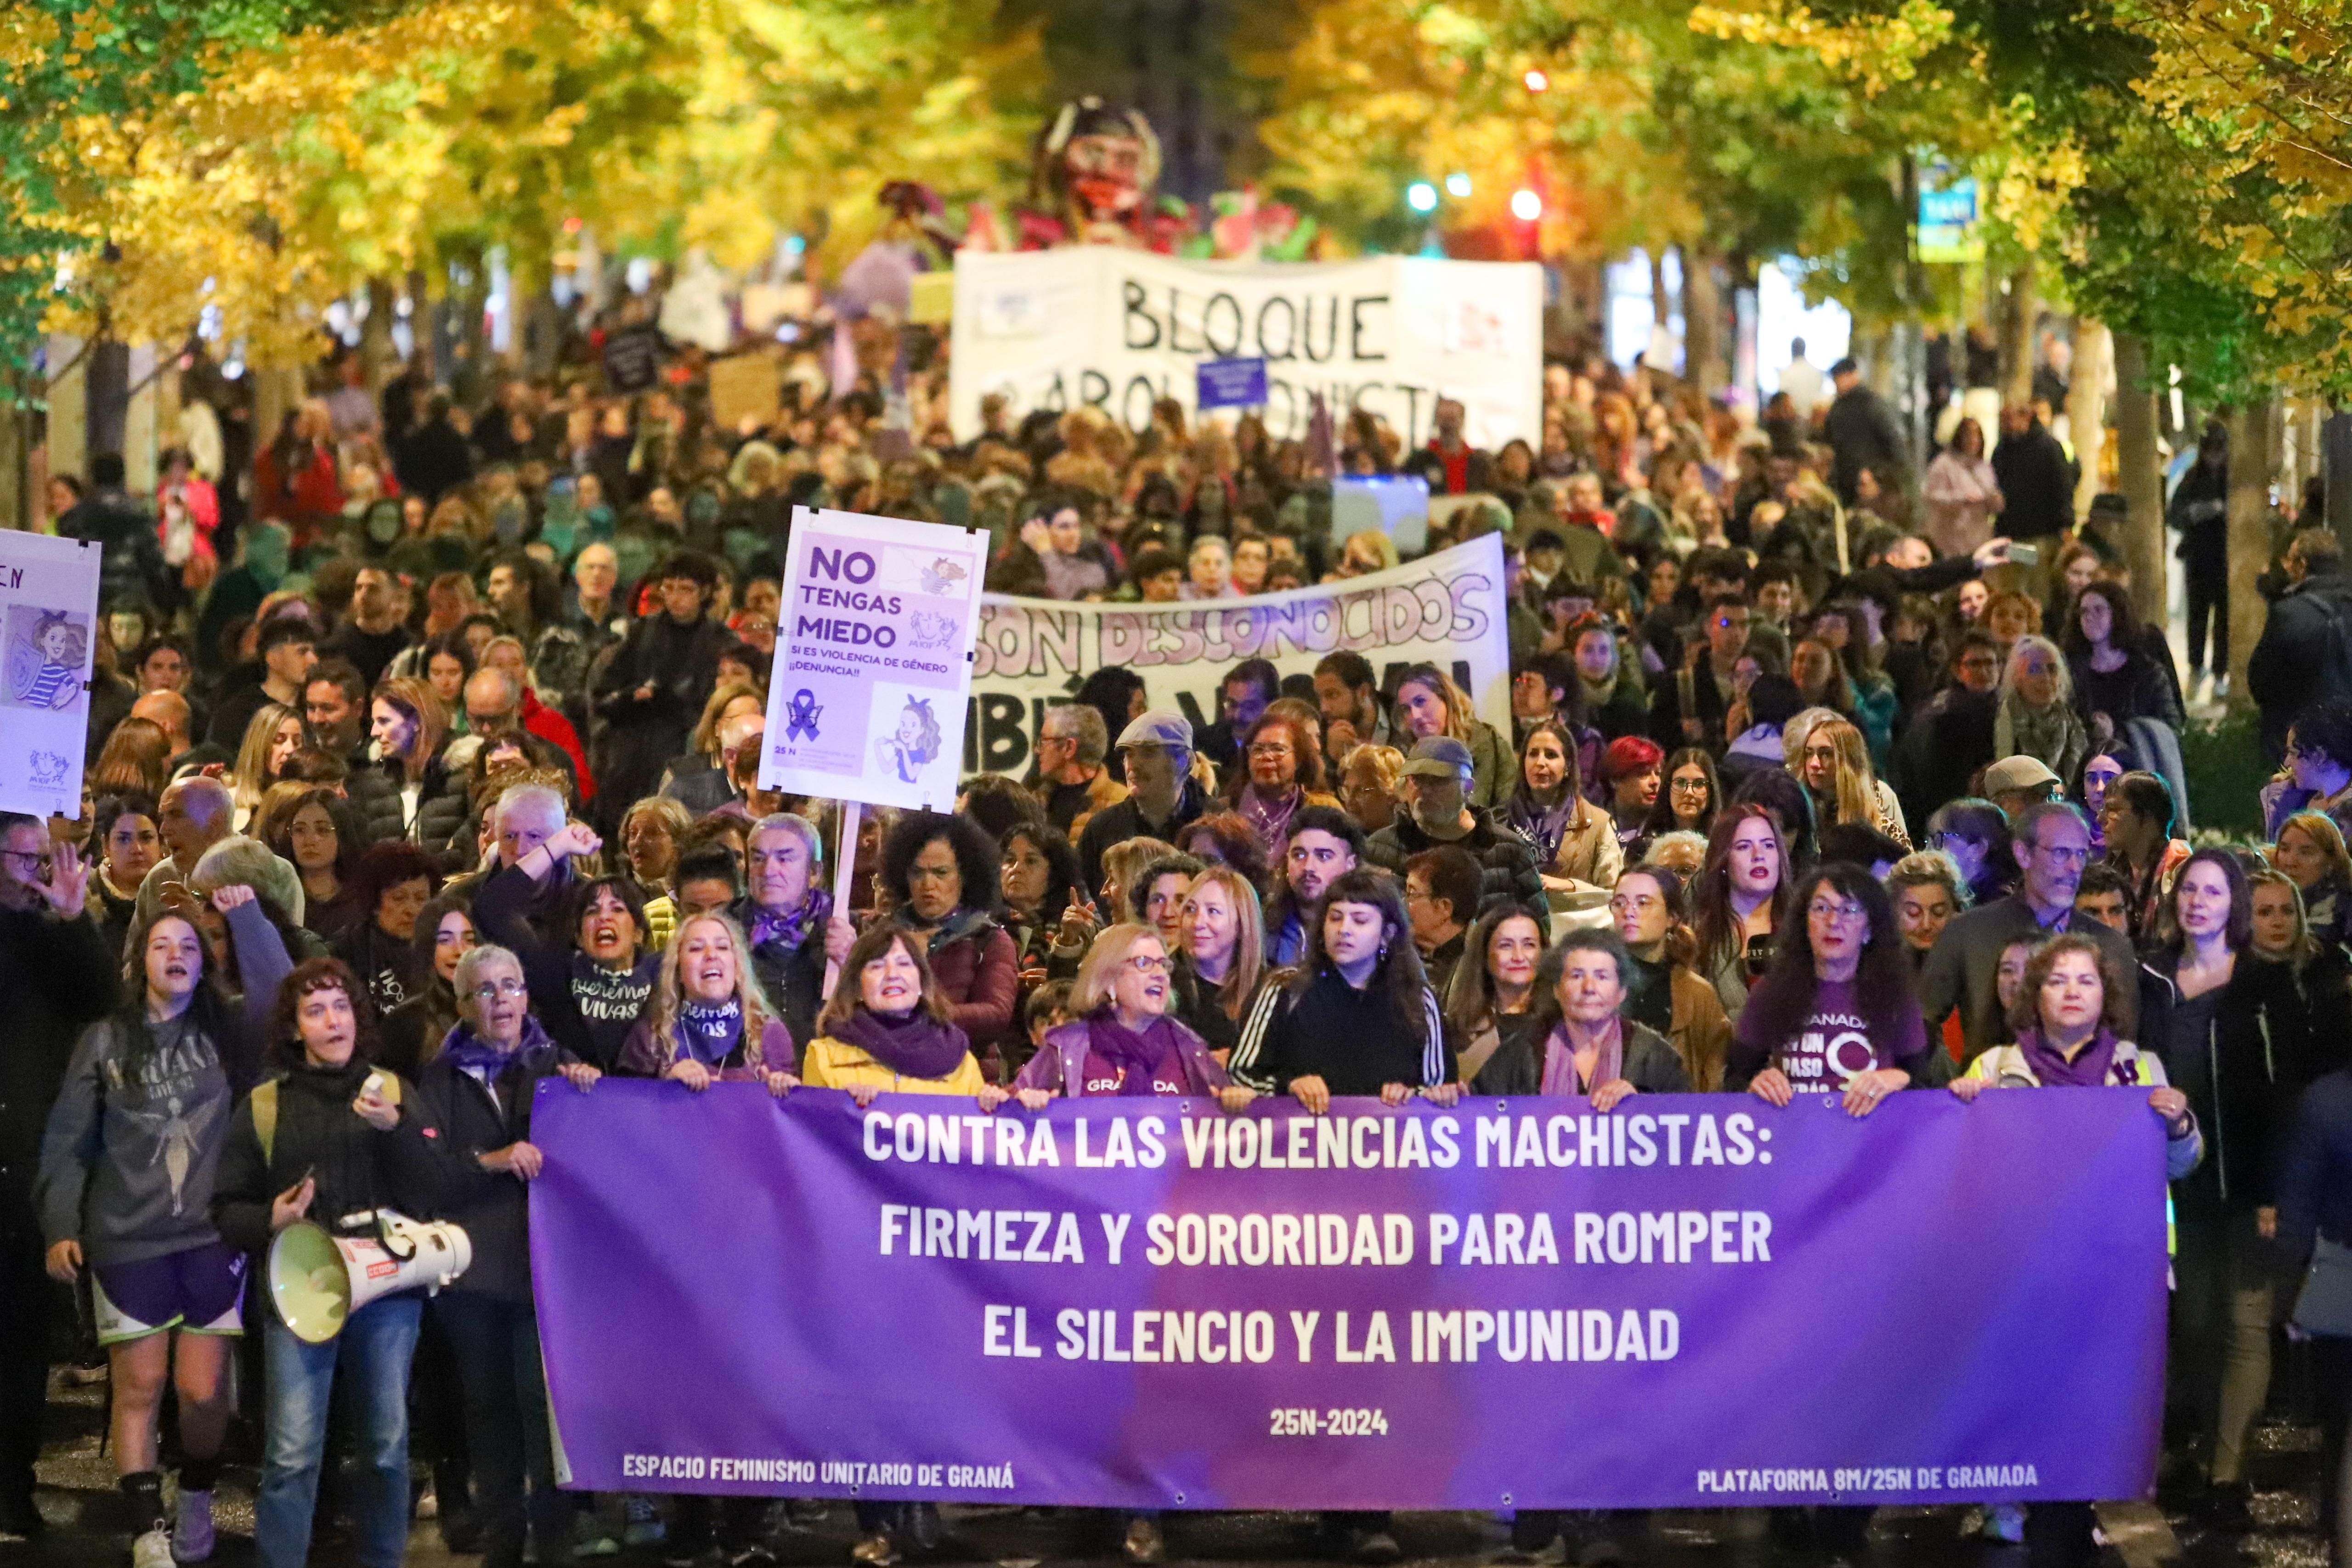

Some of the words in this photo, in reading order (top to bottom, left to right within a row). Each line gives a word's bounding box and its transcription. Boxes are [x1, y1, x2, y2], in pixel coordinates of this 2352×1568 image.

[1123, 279, 1390, 363] BLOQUE
[809, 546, 876, 584] NO
[799, 585, 902, 615] TENGAS
[797, 615, 896, 649] MIEDO
[1097, 573, 1491, 667] DESCONOCIDOS
[789, 661, 860, 677] ¡¡DENUNCIA!!
[803, 647, 817, 657] ES
[820, 649, 881, 665] VIOLENCIA
[884, 657, 899, 667] DE
[902, 659, 948, 673] GÉNERO
[775, 745, 786, 754] 25
[1801, 1033, 1824, 1053] UN
[1782, 1057, 1823, 1077] PASO
[863, 1111, 1061, 1167] CONTRA
[1074, 1115, 1167, 1168] LAS
[1180, 1115, 1461, 1169] VIOLENCIAS
[1476, 1113, 1772, 1168] MACHISTAS:
[880, 1204, 1085, 1264] FIRMEZA
[1100, 1213, 1131, 1264] Y
[1146, 1213, 1413, 1266] SORORIDAD
[1429, 1213, 1559, 1265] PARA
[1574, 1211, 1772, 1264] ROMPER
[984, 1304, 1042, 1358] EL
[1056, 1308, 1275, 1363] SILENCIO
[1289, 1311, 1320, 1362] Y
[1335, 1311, 1396, 1362] LA
[1411, 1309, 1679, 1363] IMPUNIDAD
[1270, 1409, 1388, 1436] 25N-2024
[623, 1455, 705, 1479] ESPACIO
[710, 1458, 816, 1483] FEMINISMO
[820, 1461, 913, 1486] UNITARIO
[917, 1465, 943, 1487] DE
[947, 1461, 1014, 1489] GRANÁ
[1697, 1470, 1829, 1492] PLATAFORMA
[1833, 1467, 1911, 1491] 8M/25N
[1917, 1467, 1942, 1489] DE
[1947, 1465, 2038, 1489] GRANADA
